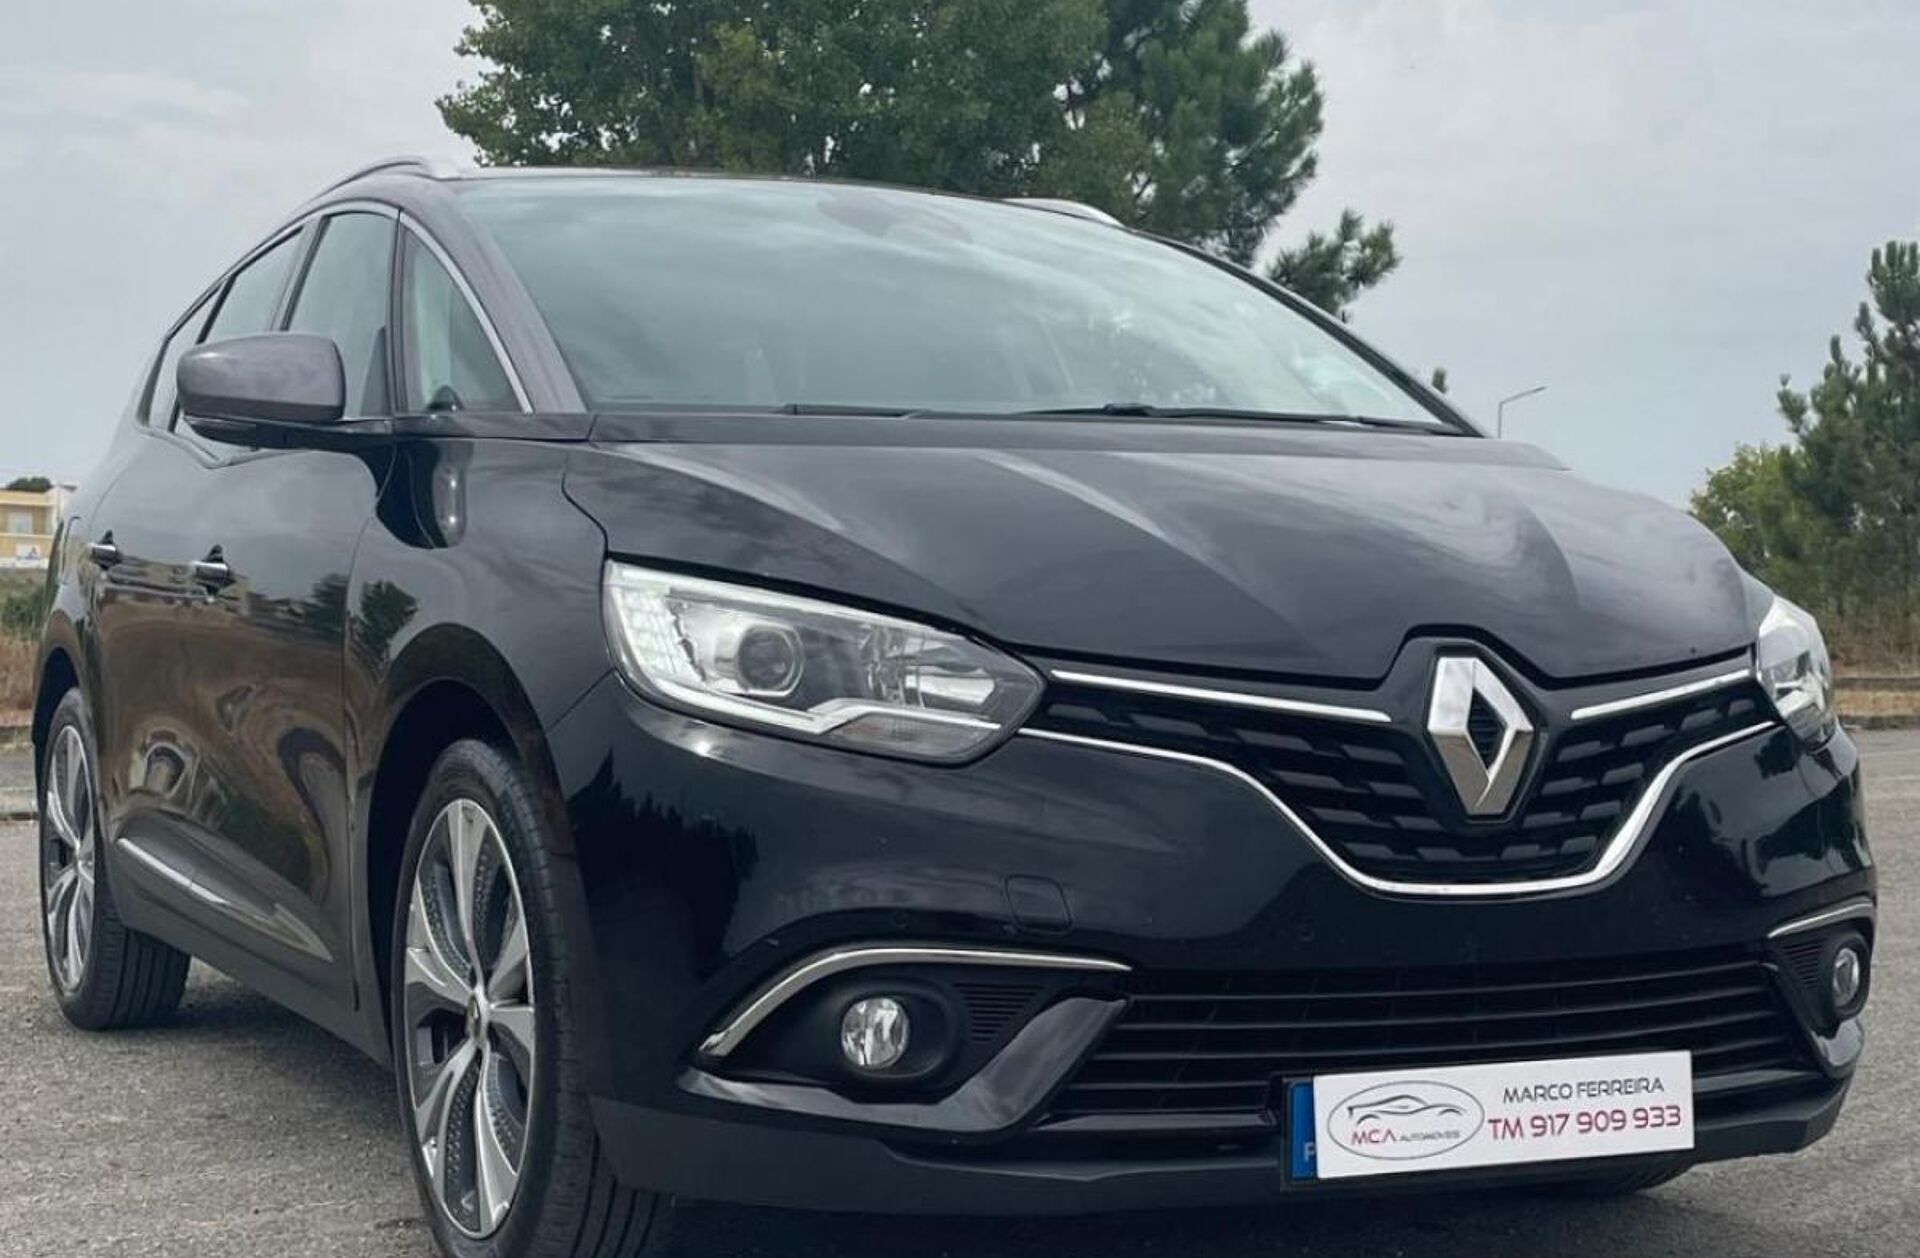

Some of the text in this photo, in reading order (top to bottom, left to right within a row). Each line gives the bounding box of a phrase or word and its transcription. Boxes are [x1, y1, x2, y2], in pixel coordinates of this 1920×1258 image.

[1503, 1077, 1665, 1104] MARCO FERREIRA
[1488, 1104, 1682, 1140] TM 917 909 933
[1352, 1129, 1397, 1146] MCA
